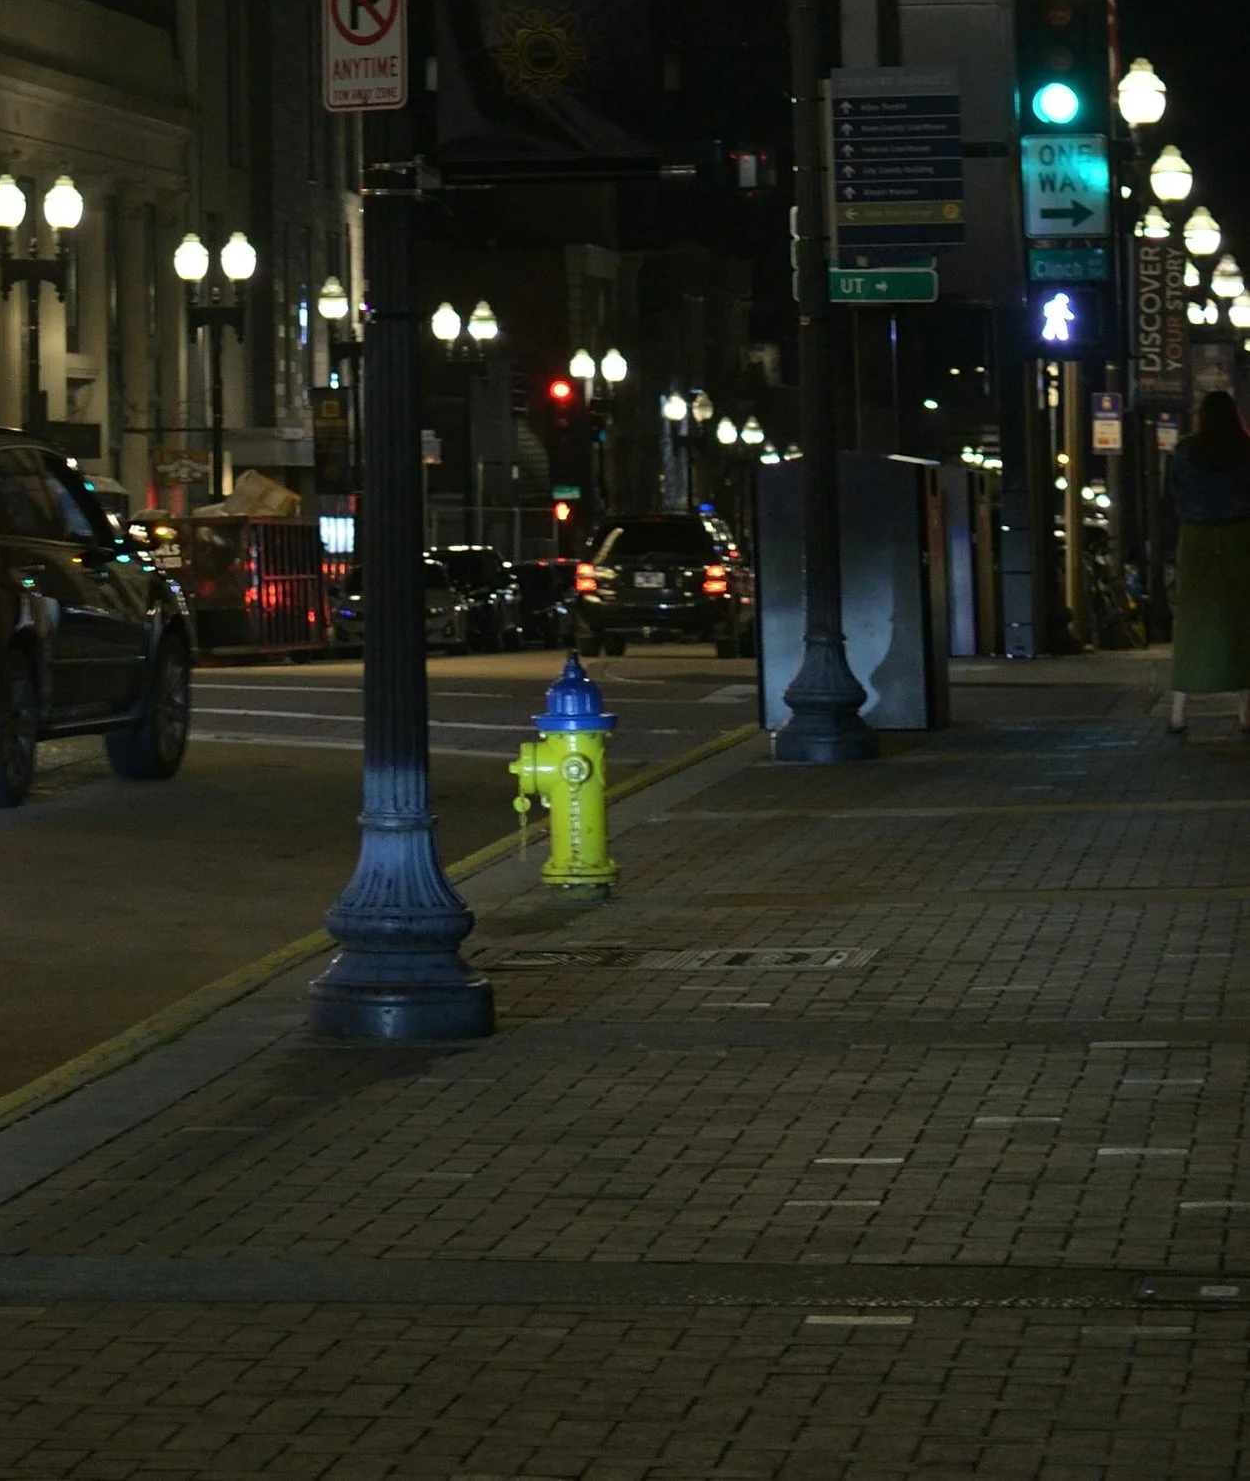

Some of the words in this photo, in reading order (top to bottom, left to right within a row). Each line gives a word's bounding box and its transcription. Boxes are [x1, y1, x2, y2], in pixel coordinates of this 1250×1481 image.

[333, 56, 399, 79] ANYTIME
[1039, 144, 1091, 166] ONE
[840, 277, 867, 294] UT
[1166, 246, 1183, 311] STORY
[1138, 246, 1162, 372] DISCOVER
[1166, 315, 1183, 372] YOUR
